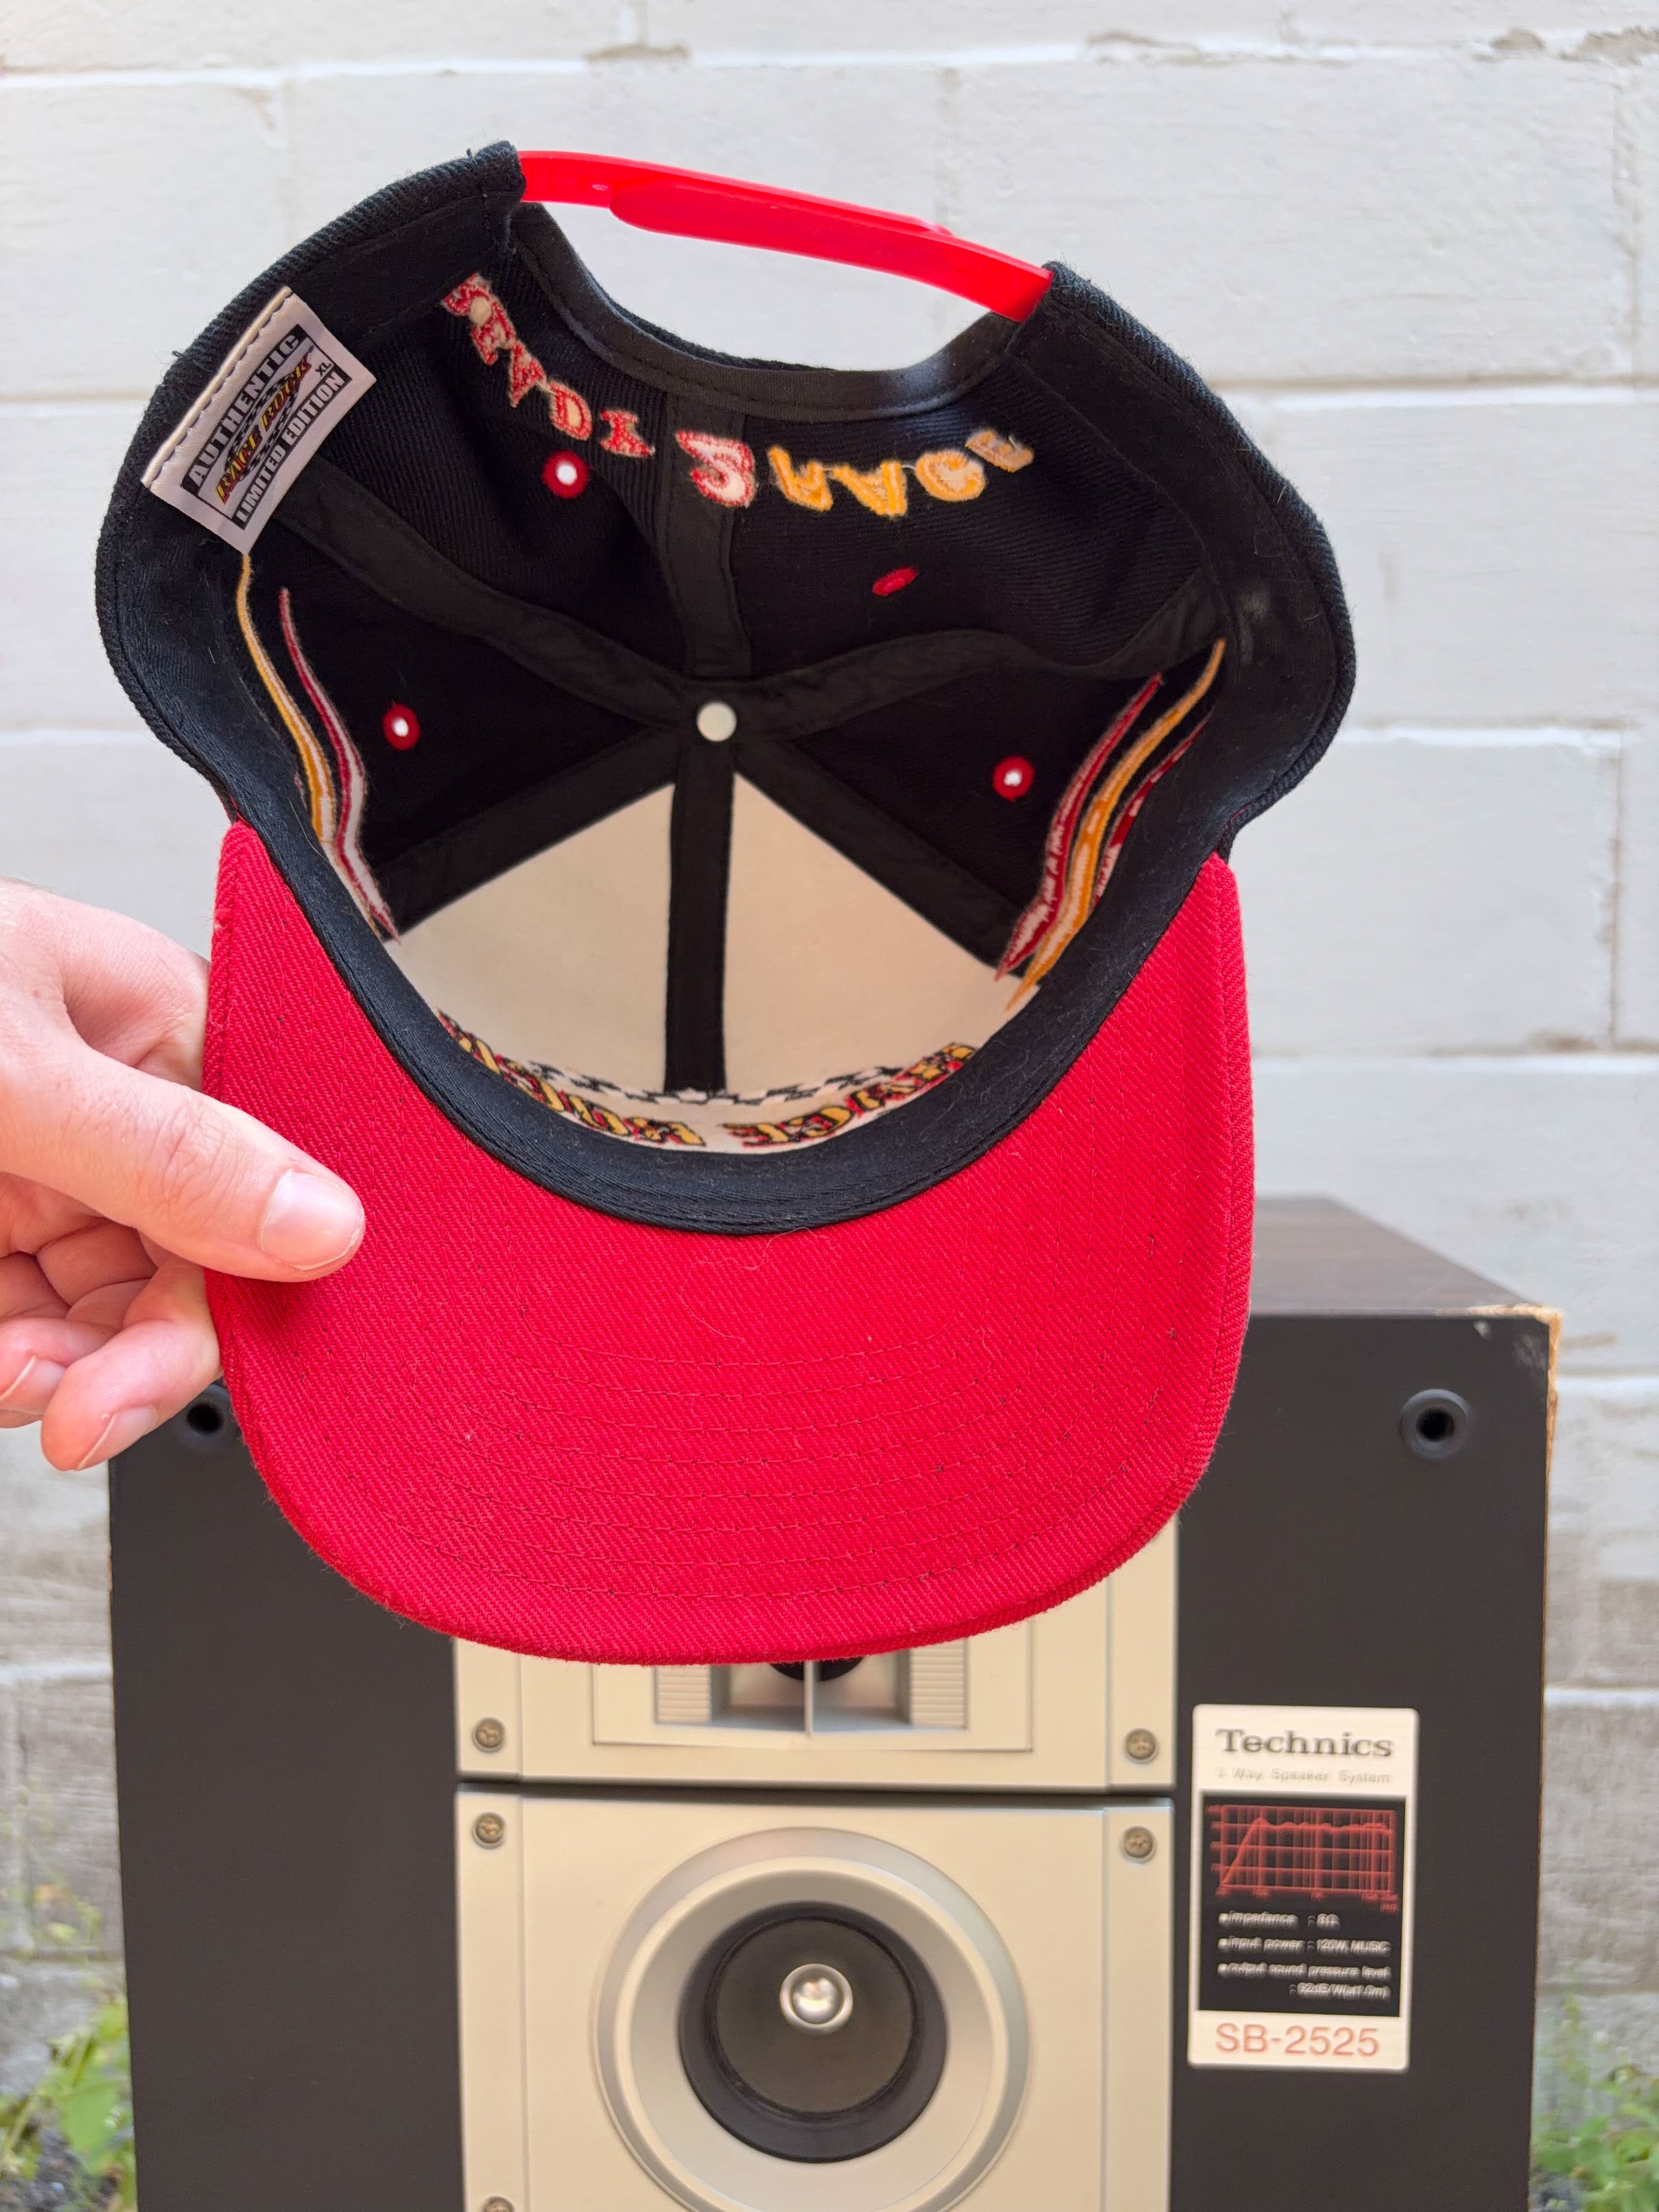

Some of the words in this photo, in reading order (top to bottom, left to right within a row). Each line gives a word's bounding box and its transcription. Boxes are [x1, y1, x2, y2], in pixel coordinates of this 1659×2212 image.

[188, 334, 300, 488] AUTHENTIC
[216, 425, 263, 505] RACE
[235, 444, 286, 523] LIMITED
[280, 371, 345, 446] EDITION
[1215, 1728, 1394, 1757] Technics
[1232, 1767, 1263, 1782] Way
[1271, 1767, 1331, 1783] Speaker
[1338, 1770, 1392, 1785] System
[1215, 2022, 1380, 2057] SB-2525
